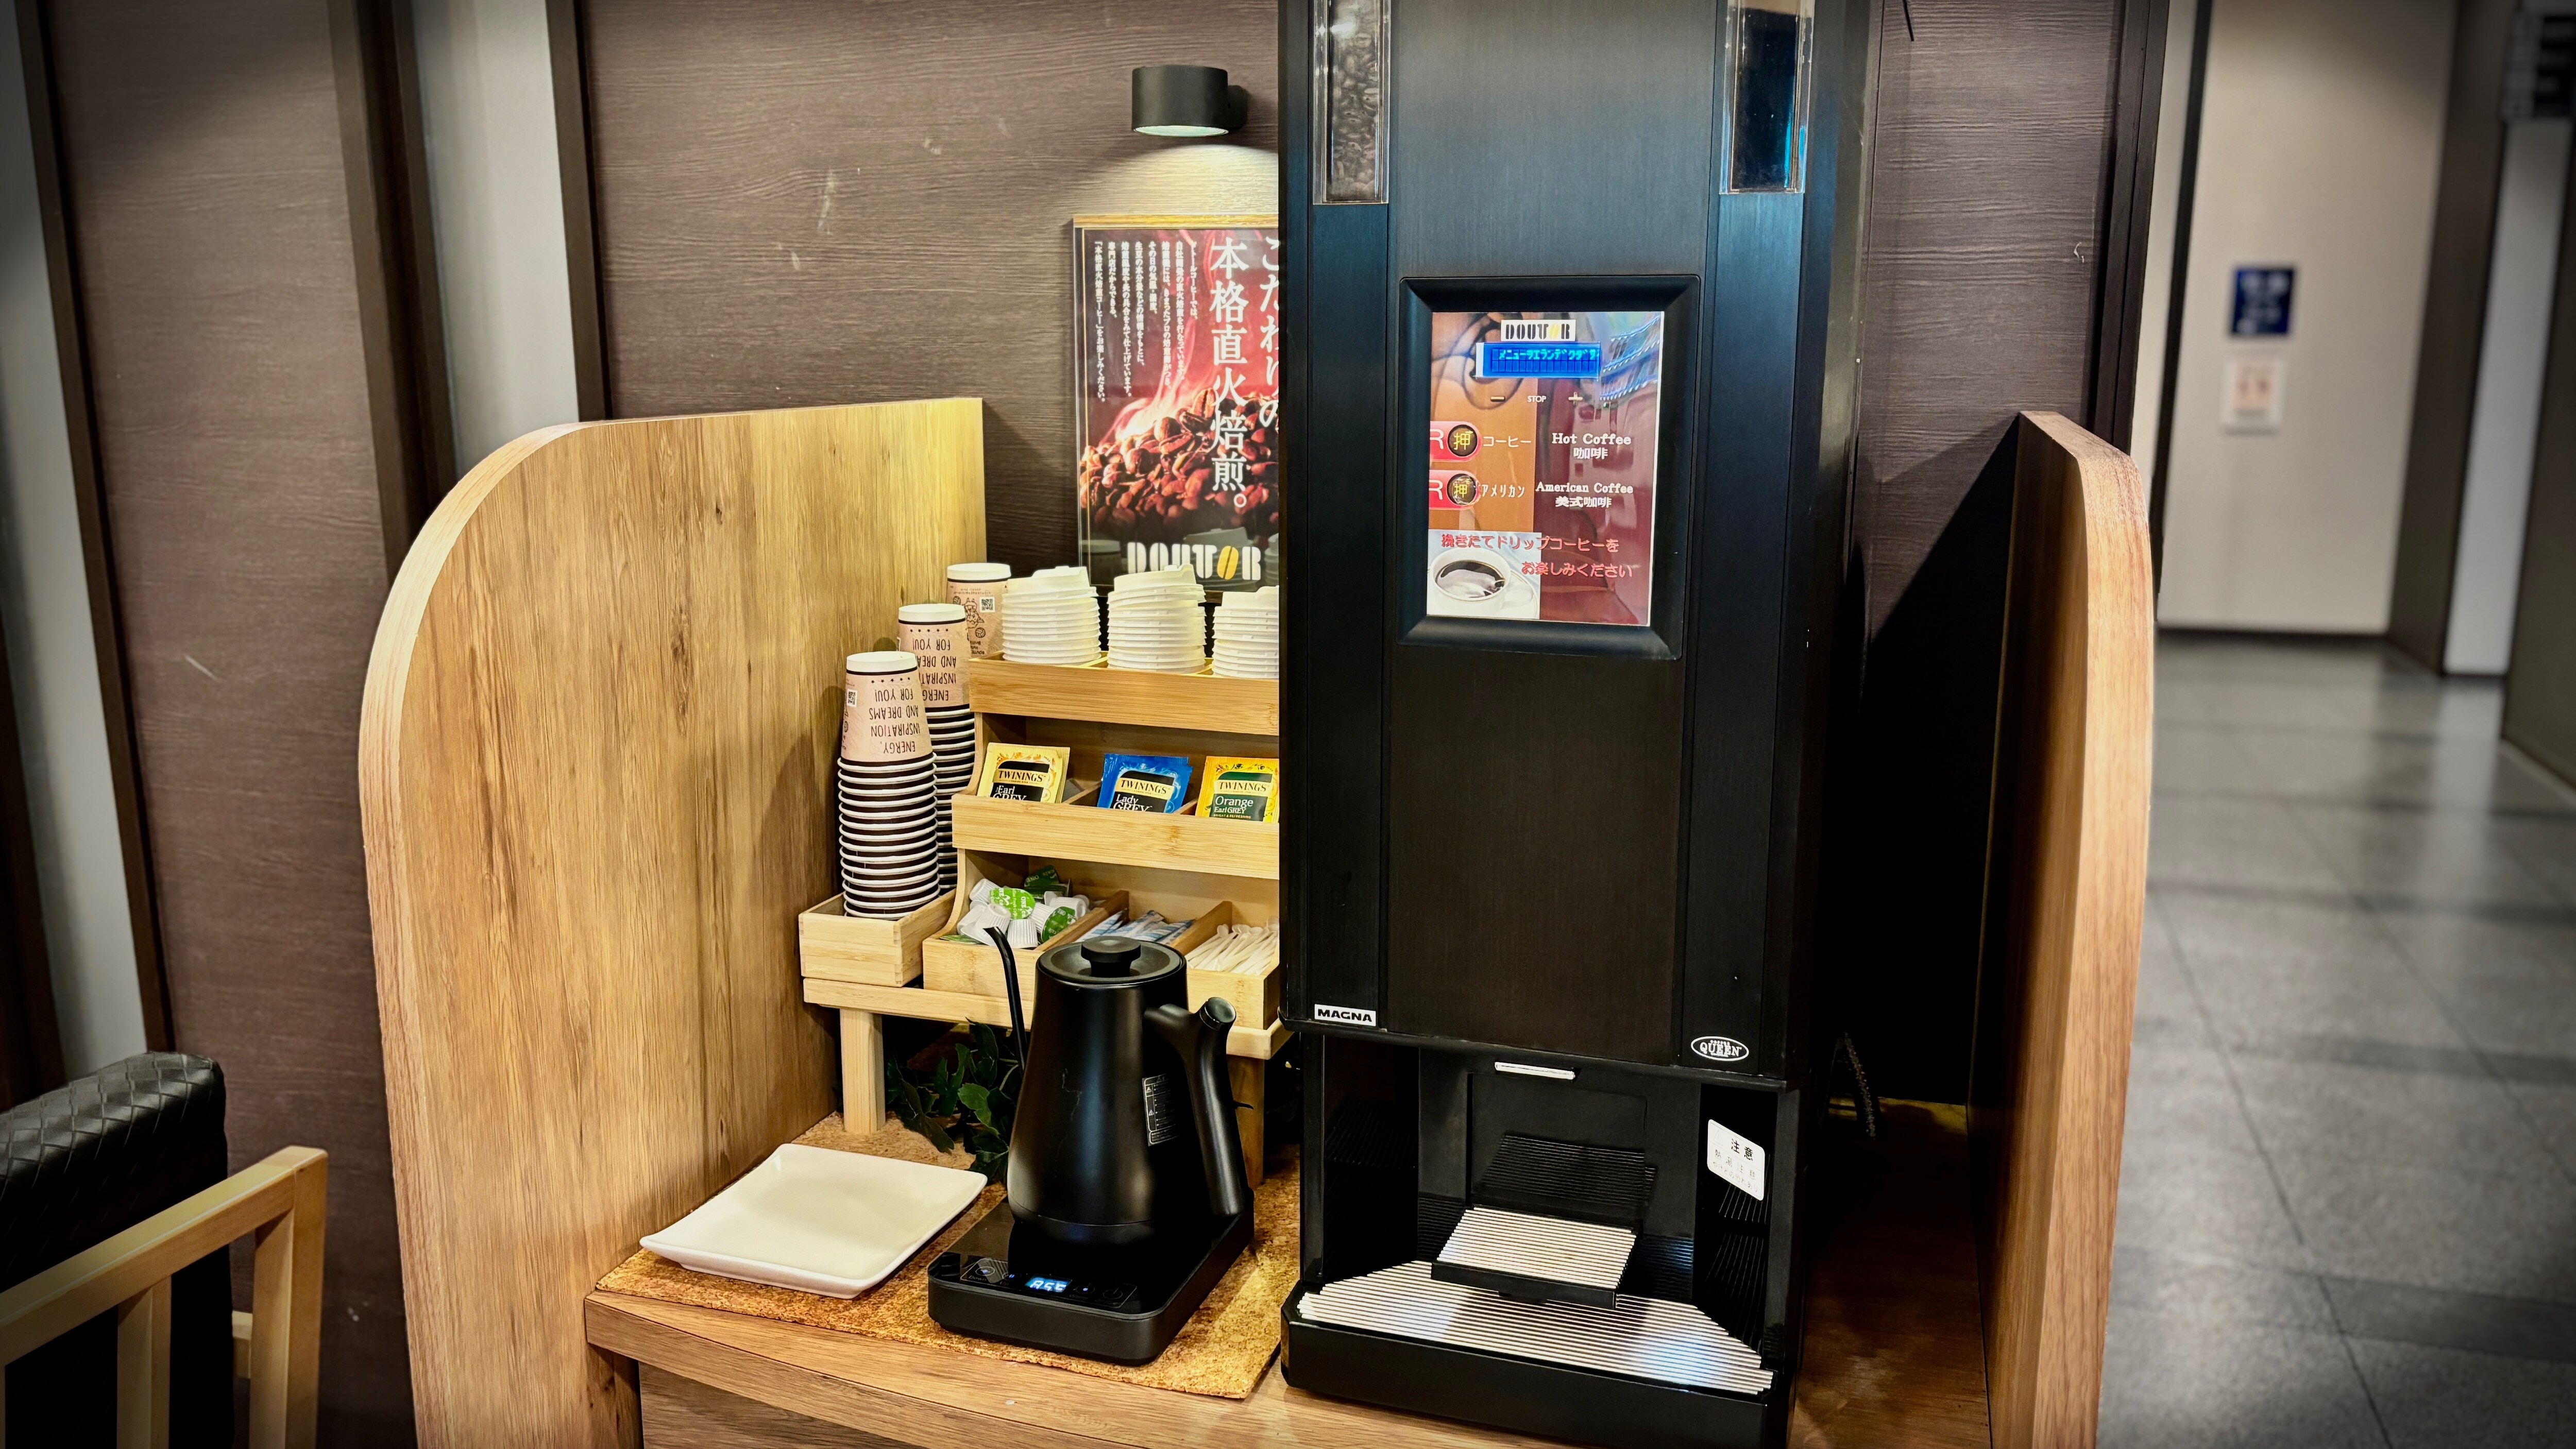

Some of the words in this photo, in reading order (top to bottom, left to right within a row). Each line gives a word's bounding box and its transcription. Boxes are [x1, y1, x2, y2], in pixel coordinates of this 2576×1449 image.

[1505, 323, 1570, 339] DOUTOR
[1210, 236, 1249, 507] 本格直火焙煎。
[1527, 395, 1547, 403] STOP
[1453, 432, 1471, 450] 押
[1483, 435, 1532, 448] コーヒー
[1552, 433, 1577, 445] Hot
[1583, 433, 1632, 446] Coffee
[1573, 447, 1608, 459] 咖啡
[1454, 484, 1467, 499] 押
[1482, 484, 1526, 499] アメリカン
[1535, 483, 1589, 493] American
[1594, 483, 1634, 495] Coffee
[1555, 496, 1612, 508] 美式咖啡
[1441, 534, 1619, 554] 挽きたてドリップコーヒーを
[1127, 541, 1261, 581] DOUTOR
[1521, 561, 1633, 578] お楽しみください
[912, 638, 931, 651] YOU!
[937, 639, 951, 651] FOR
[917, 655, 936, 668] DREA
[941, 656, 957, 668] AND
[919, 673, 957, 685] INSPIRAT
[875, 689, 896, 702] YOU!
[901, 688, 913, 701] FOR
[922, 689, 949, 701] ENERG
[869, 706, 902, 720] DREAMS
[906, 705, 919, 718] AND
[871, 723, 920, 737] INSPIRATION
[999, 770, 1043, 782] TWININGS
[997, 785, 1015, 794] Earl
[1121, 780, 1167, 794] TWININGS
[1219, 781, 1266, 792] TWININGS
[1116, 794, 1139, 804] Lady
[1215, 796, 1253, 808] Orange
[1317, 1009, 1372, 1022] MAGNA
[1700, 1042, 1742, 1057] QUEEN
[1731, 1138, 1753, 1161] 注意
